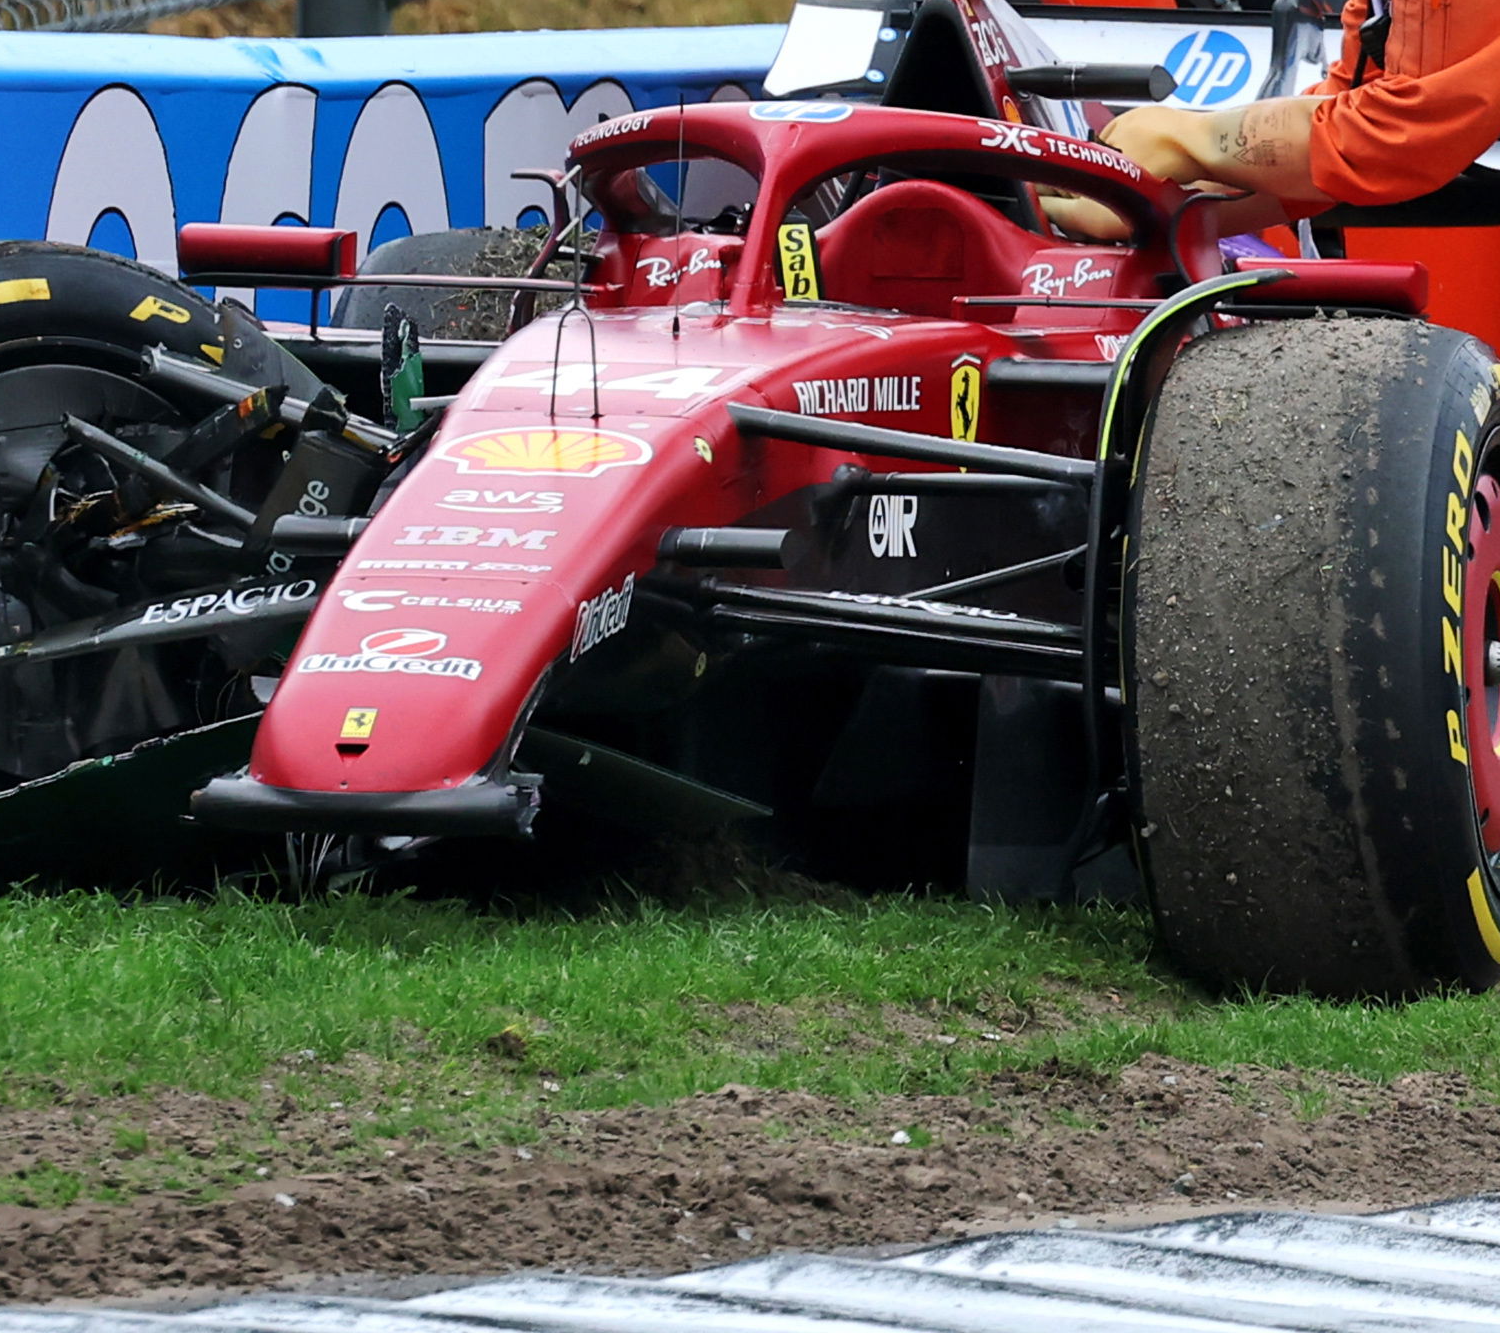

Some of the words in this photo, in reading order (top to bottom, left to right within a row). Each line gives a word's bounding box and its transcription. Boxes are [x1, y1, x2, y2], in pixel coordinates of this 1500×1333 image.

[1172, 30, 1248, 105] hp
[572, 114, 654, 149] TECHNOLOGY
[977, 119, 1042, 158] DXC
[1045, 136, 1142, 182] TECHNOLOGY
[1021, 257, 1113, 297] Ray-Ban
[485, 362, 724, 401] 44
[792, 376, 869, 415] RICHARD
[873, 375, 922, 412] MILLE
[443, 488, 565, 505] aws
[393, 525, 558, 550] IBM
[139, 578, 317, 626] ESPACIO
[400, 595, 523, 610] CELSIUS
[300, 653, 482, 680] UniCredit
